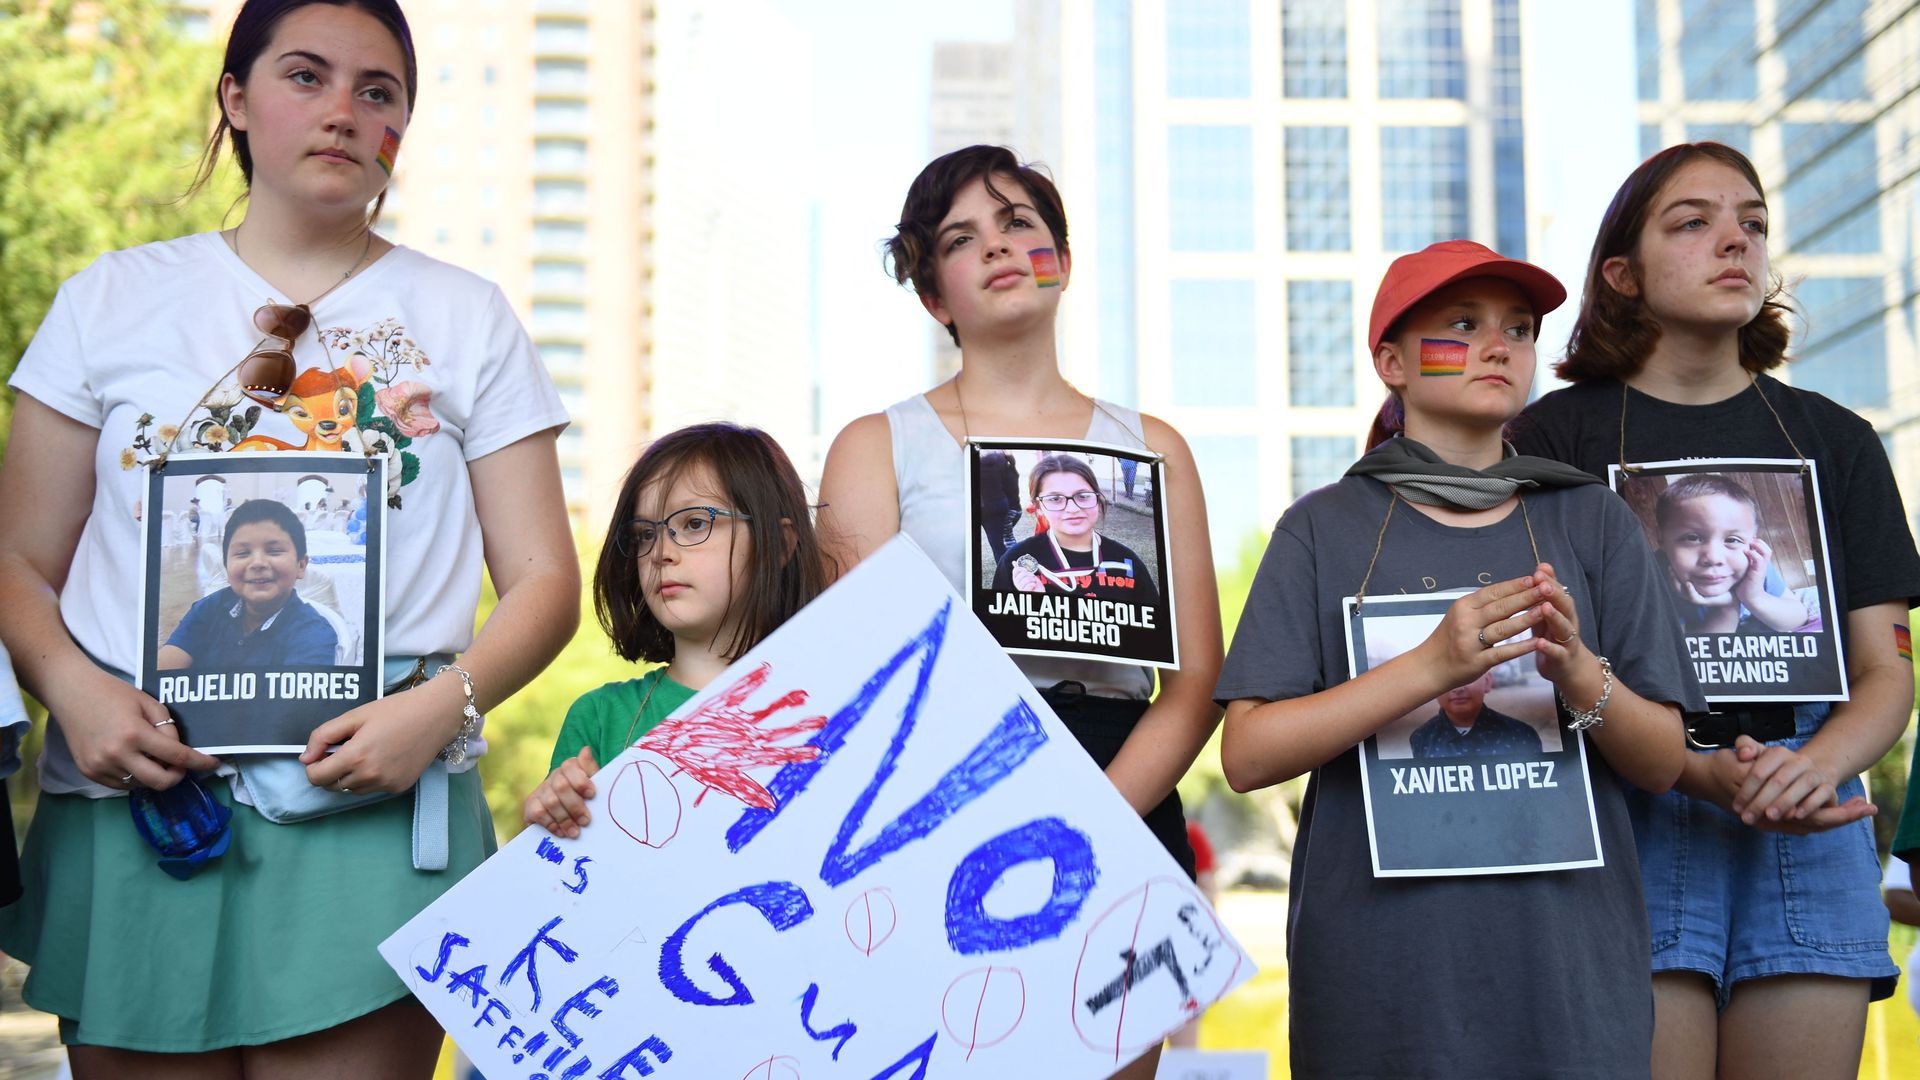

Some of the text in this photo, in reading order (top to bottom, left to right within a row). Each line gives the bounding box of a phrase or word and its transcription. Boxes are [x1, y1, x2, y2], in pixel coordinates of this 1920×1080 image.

[988, 592, 1156, 629] JAILAH NICOLE
[1026, 617, 1121, 647] SIGUERO
[1685, 635, 1818, 659] CE CARMELO
[159, 671, 360, 704] ROJELIO TORRES
[1390, 761, 1558, 794] XAVIER LOPEZ
